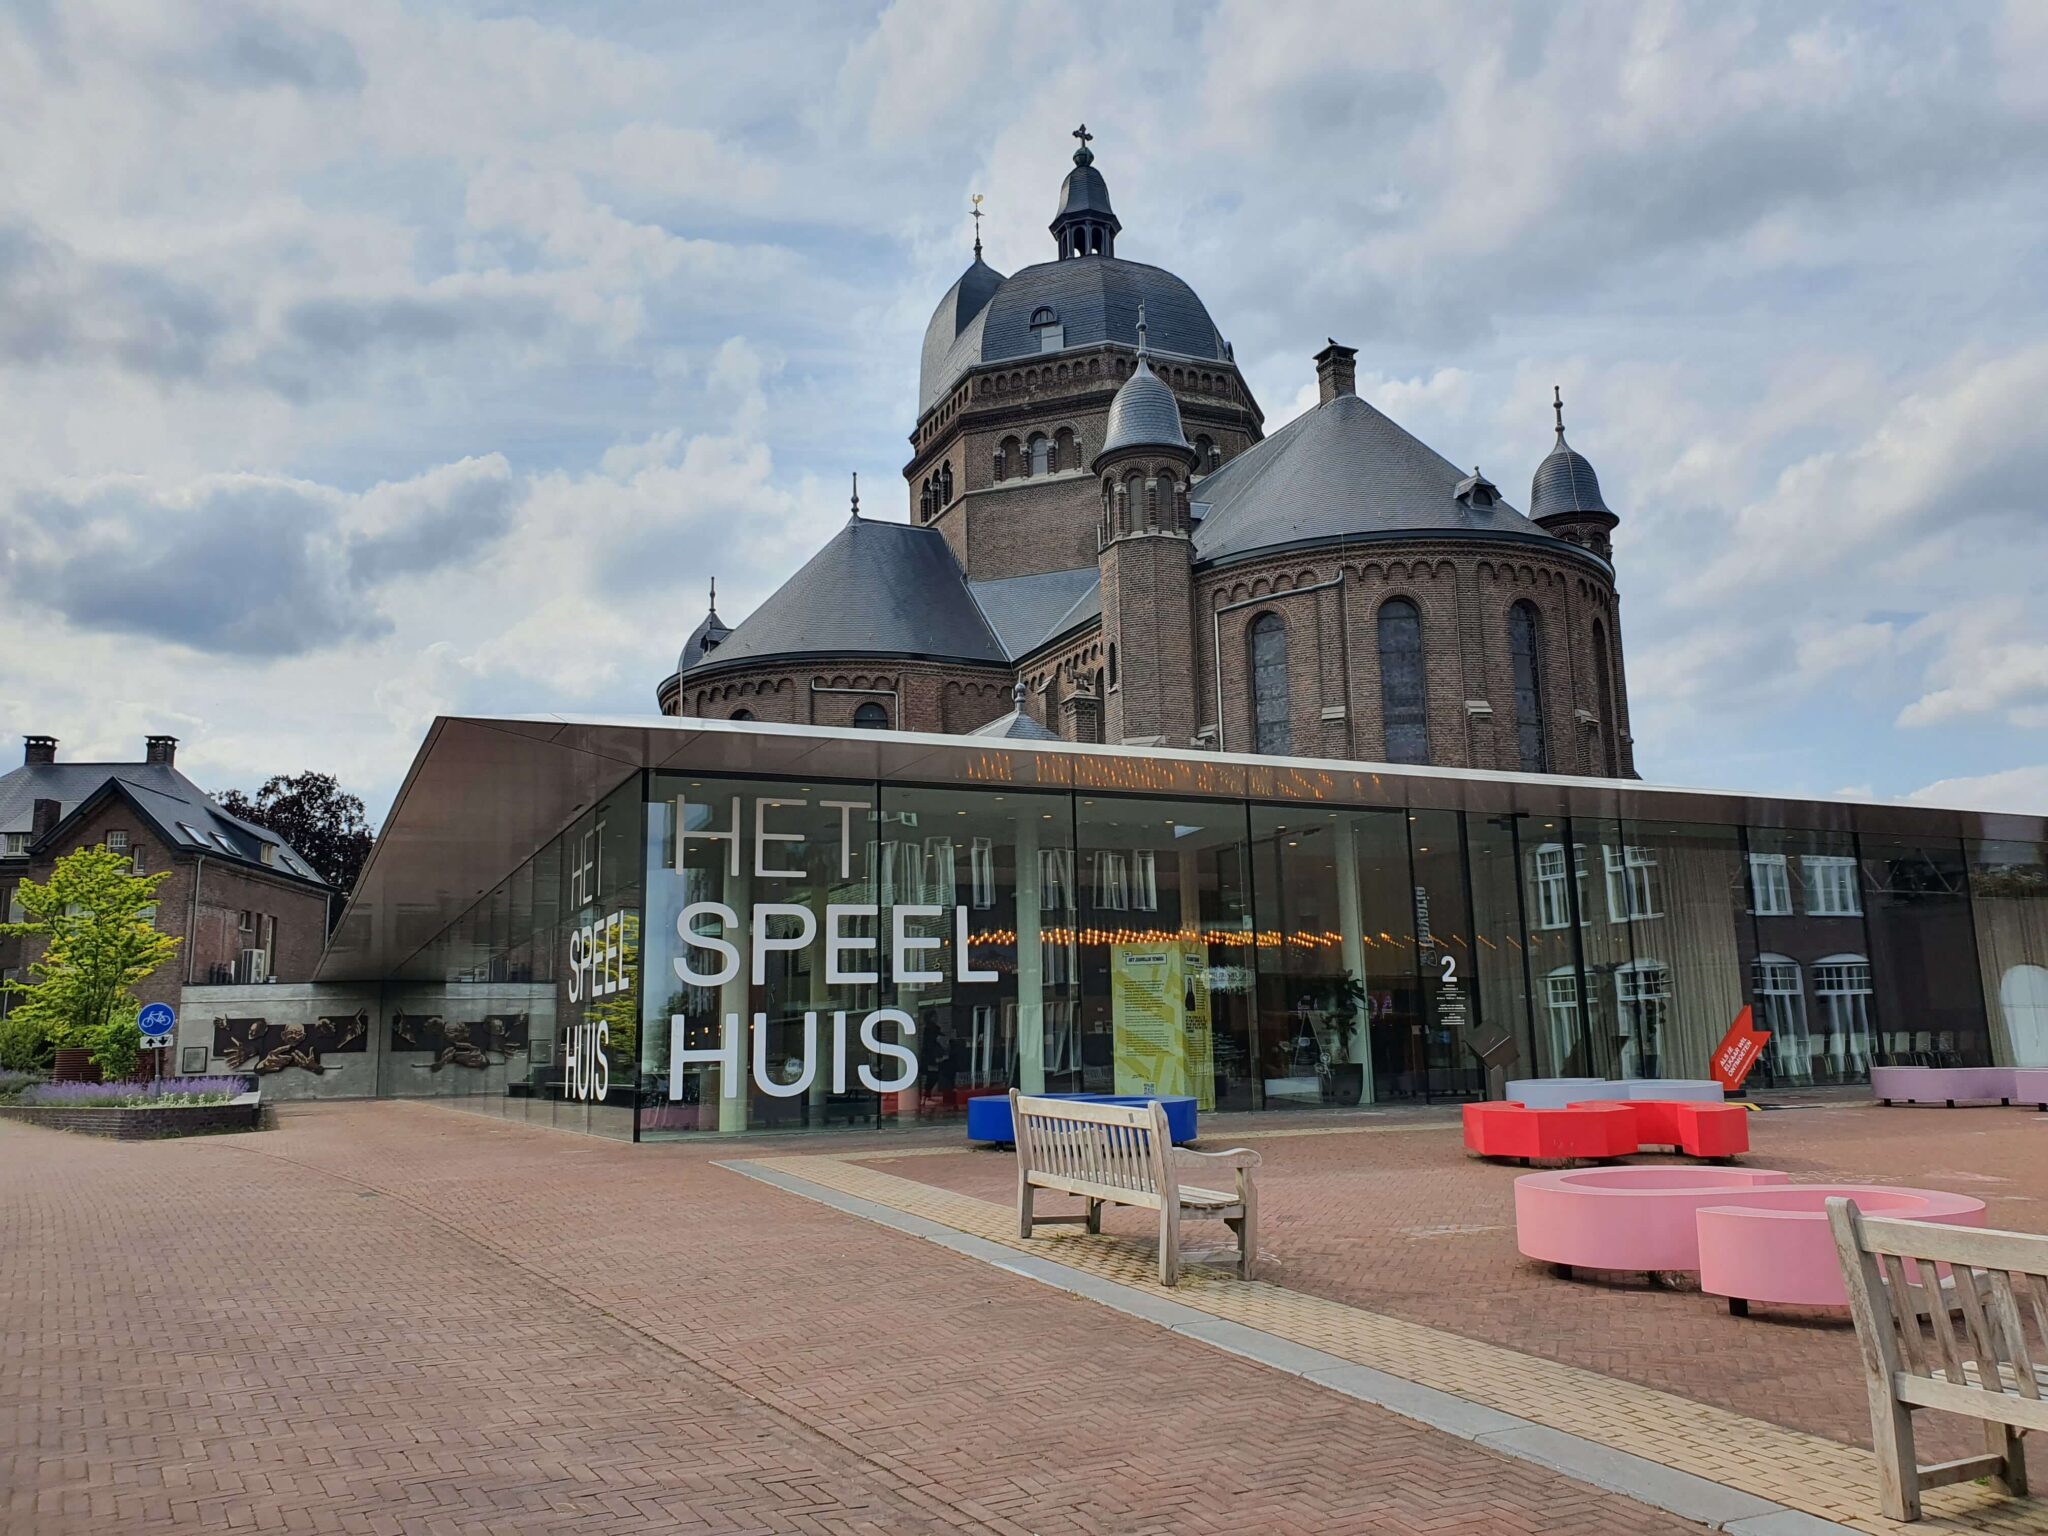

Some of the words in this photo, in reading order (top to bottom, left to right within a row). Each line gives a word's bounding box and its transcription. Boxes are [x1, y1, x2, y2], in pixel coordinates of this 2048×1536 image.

[571, 820, 606, 911] HET
[675, 794, 871, 878] HET
[569, 910, 629, 1003] SPEEL
[673, 901, 999, 986] SPEEL
[1441, 955, 1457, 982] 2
[565, 1019, 609, 1102] HUIS
[669, 1010, 918, 1100] HUIS
[1720, 1053, 1729, 1067] ALS
[1723, 1047, 1740, 1072] ELKAAR
[1728, 1039, 1752, 1077] ONTMOETEN
